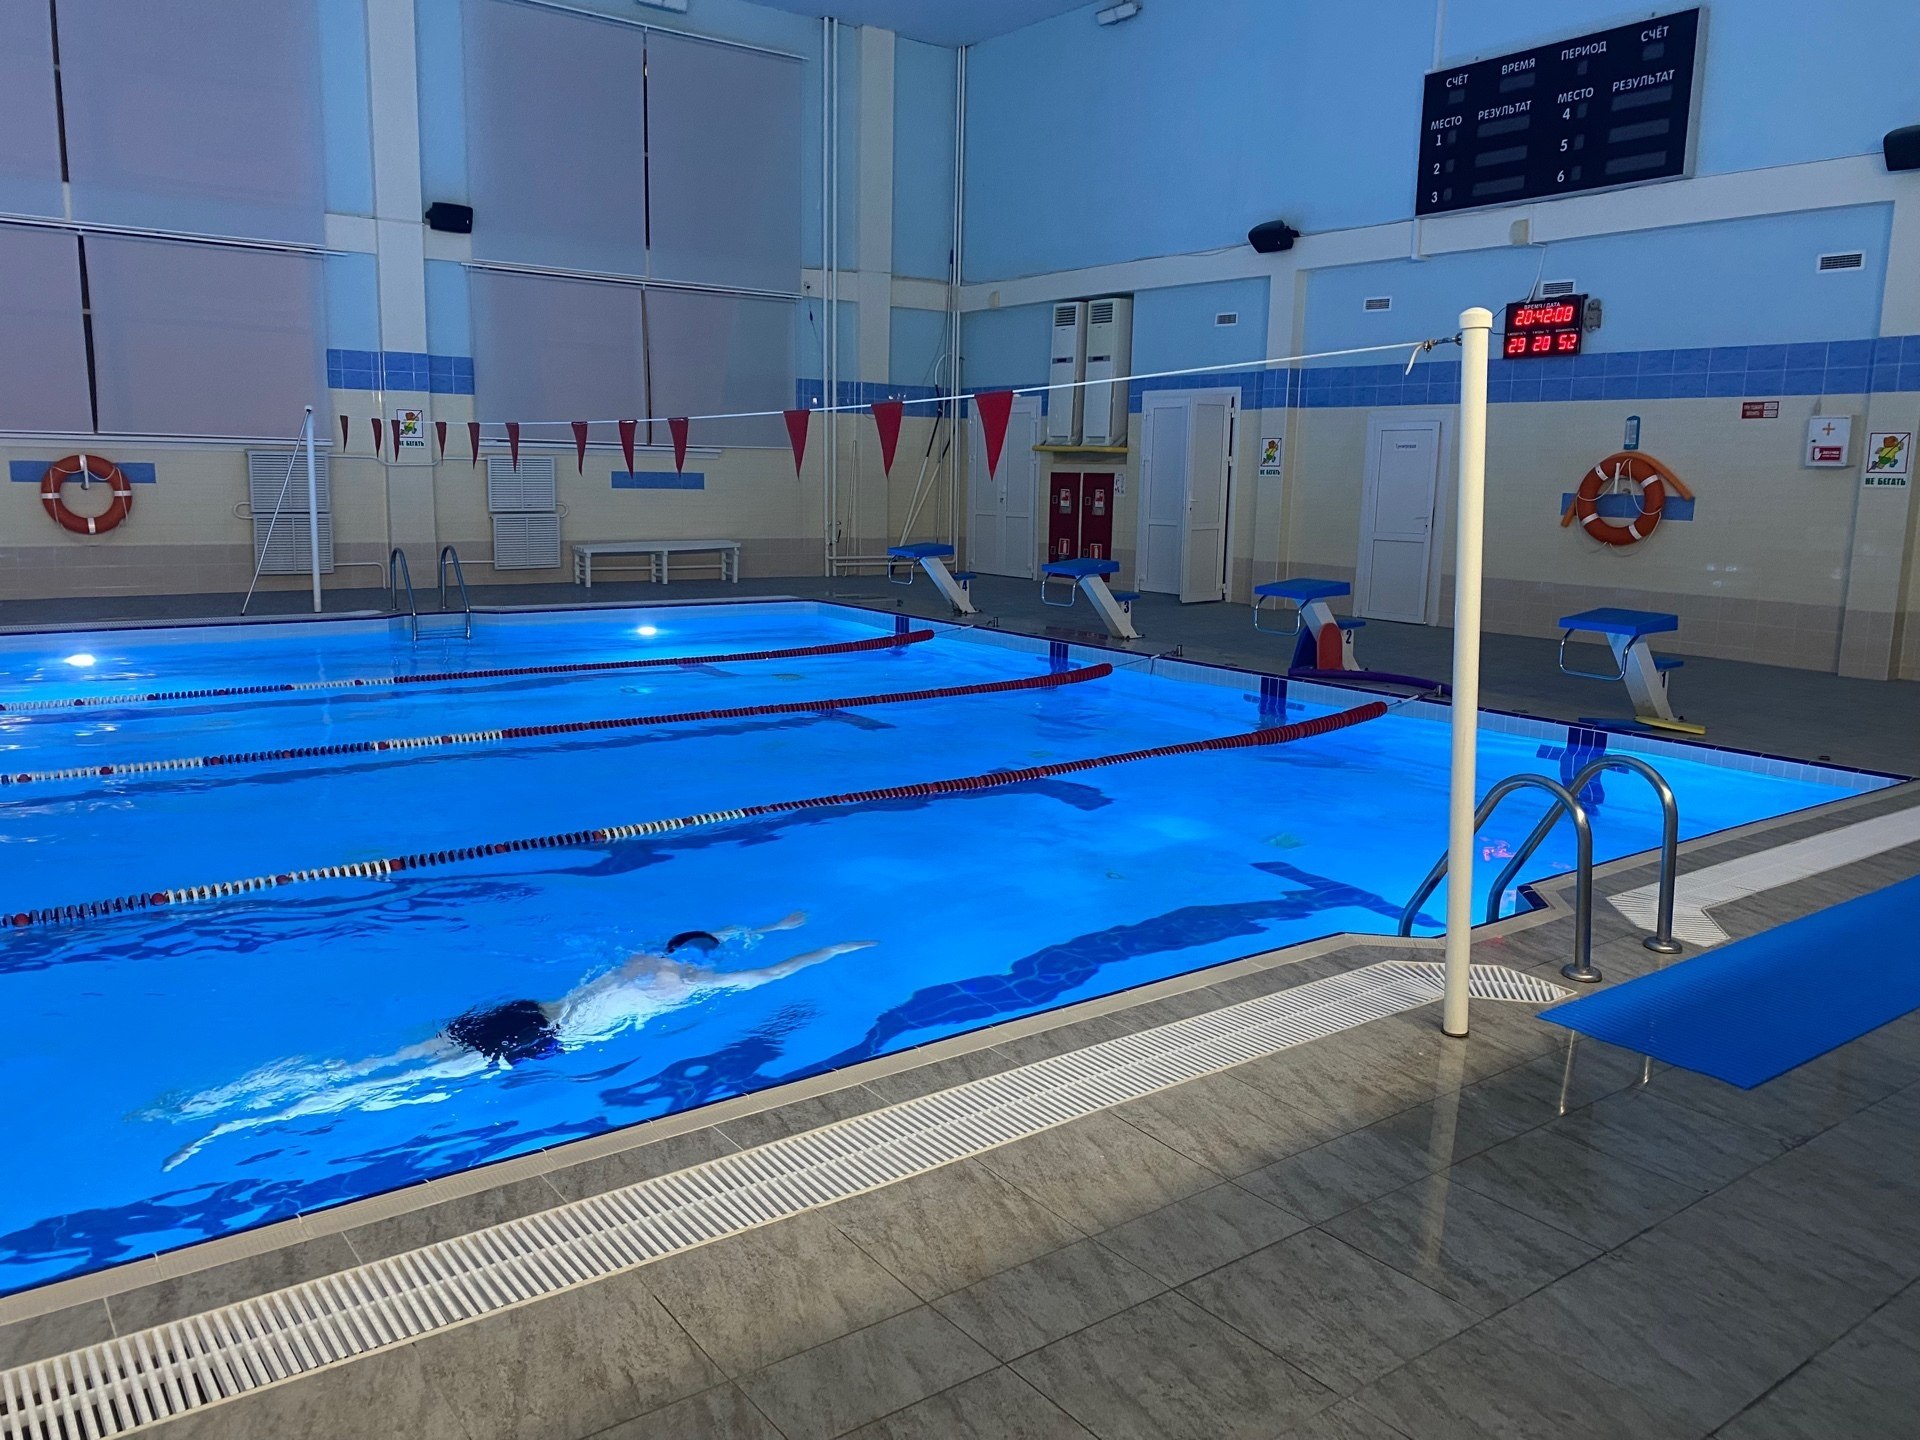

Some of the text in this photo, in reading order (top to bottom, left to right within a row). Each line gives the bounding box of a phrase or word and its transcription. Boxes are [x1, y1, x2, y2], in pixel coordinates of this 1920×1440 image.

[1641, 25, 1669, 42] СЧЁТ
[1561, 40, 1607, 61] ПЕРИОД
[1501, 58, 1536, 75] ВРЕМЯ
[1446, 73, 1469, 88] СЧЁТ
[1557, 69, 1676, 104] МЕСТО РЕЗУЛЬТАТ
[1430, 100, 1532, 131] МЕСТО РЕЗУЛЬТАТ
[1562, 107, 1571, 121] 4
[1435, 134, 1442, 147] 1
[1559, 138, 1569, 152] 5
[1433, 162, 1440, 175] 2
[1556, 169, 1565, 183] 6
[1431, 191, 1438, 203] 3
[1508, 333, 1578, 353] 29 28 52
[1865, 477, 1906, 486] НЕ БЕГАТЬ
[962, 580, 967, 591] 4
[1124, 600, 1130, 613] 3
[1346, 629, 1352, 644] 2
[1661, 671, 1666, 688] 1
